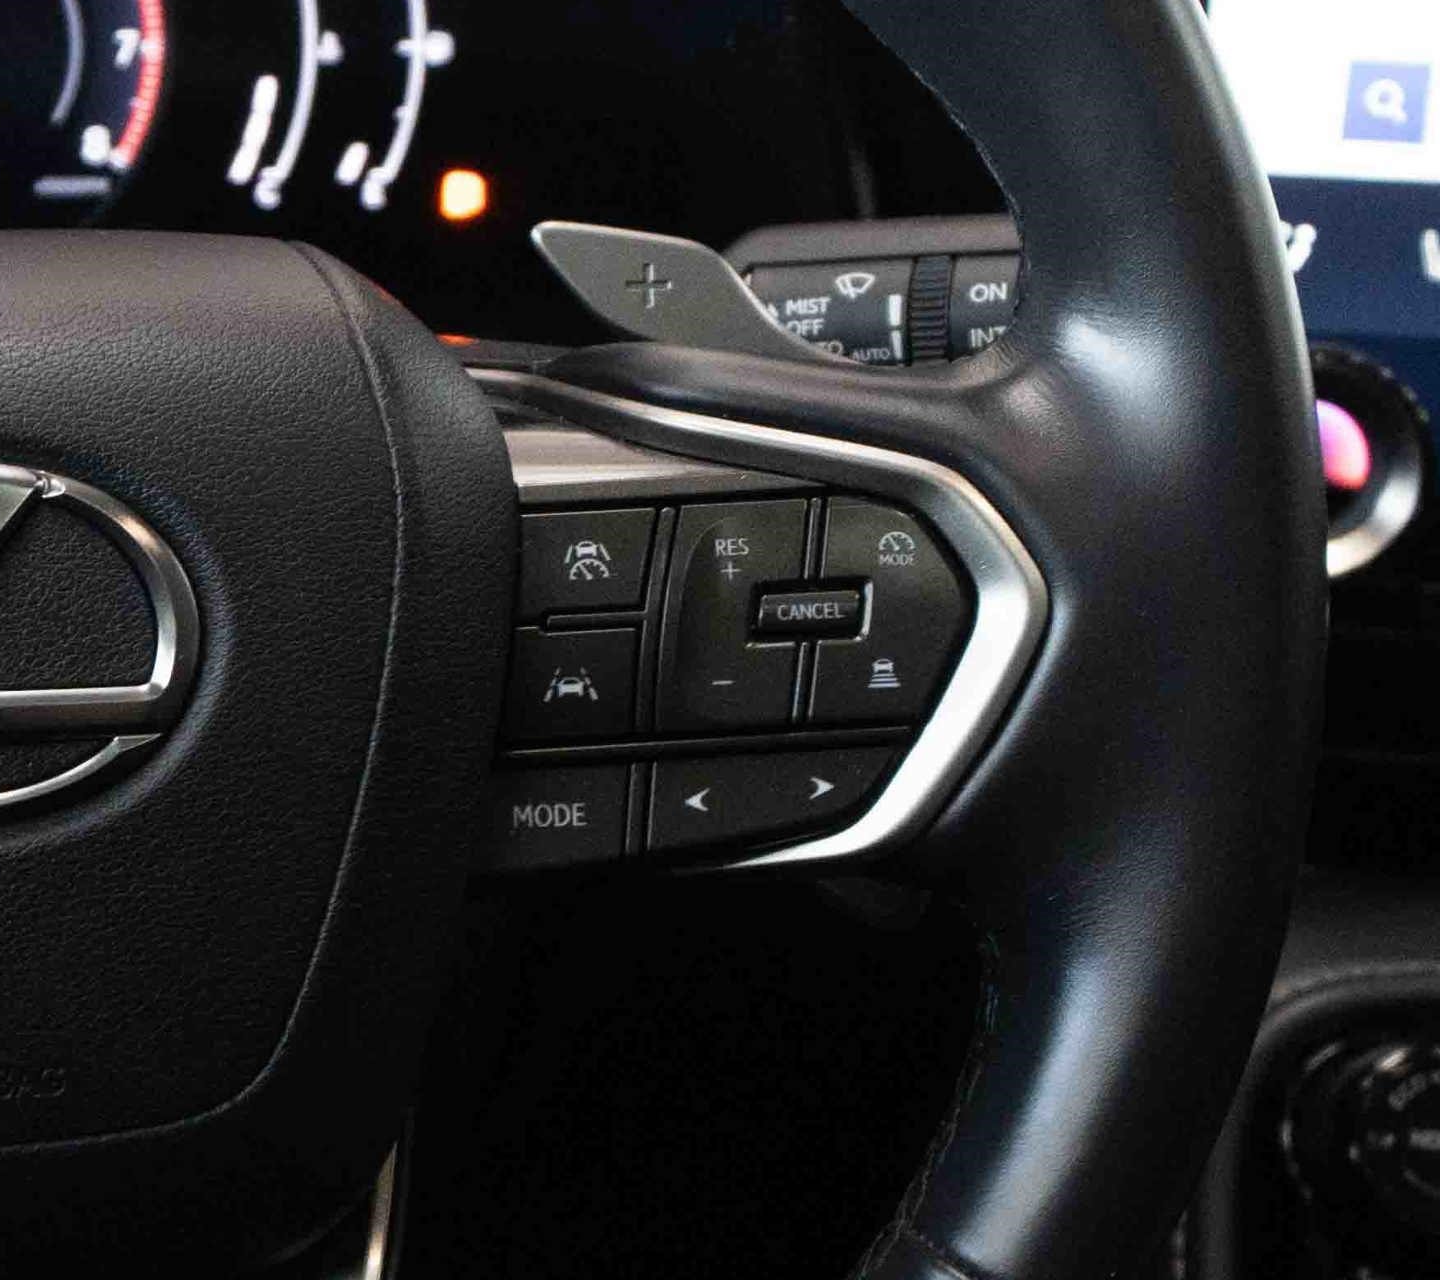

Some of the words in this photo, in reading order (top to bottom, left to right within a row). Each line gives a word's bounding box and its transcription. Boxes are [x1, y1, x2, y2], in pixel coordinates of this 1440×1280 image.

[112, 28, 141, 70] 7
[79, 124, 111, 166] 8
[970, 282, 1008, 303] ON
[785, 296, 831, 316] MIST
[852, 346, 890, 361] AUTO
[713, 538, 750, 557] RES
[878, 553, 918, 567] MODE
[776, 602, 846, 621] CANCEL
[511, 802, 588, 828] MODE
